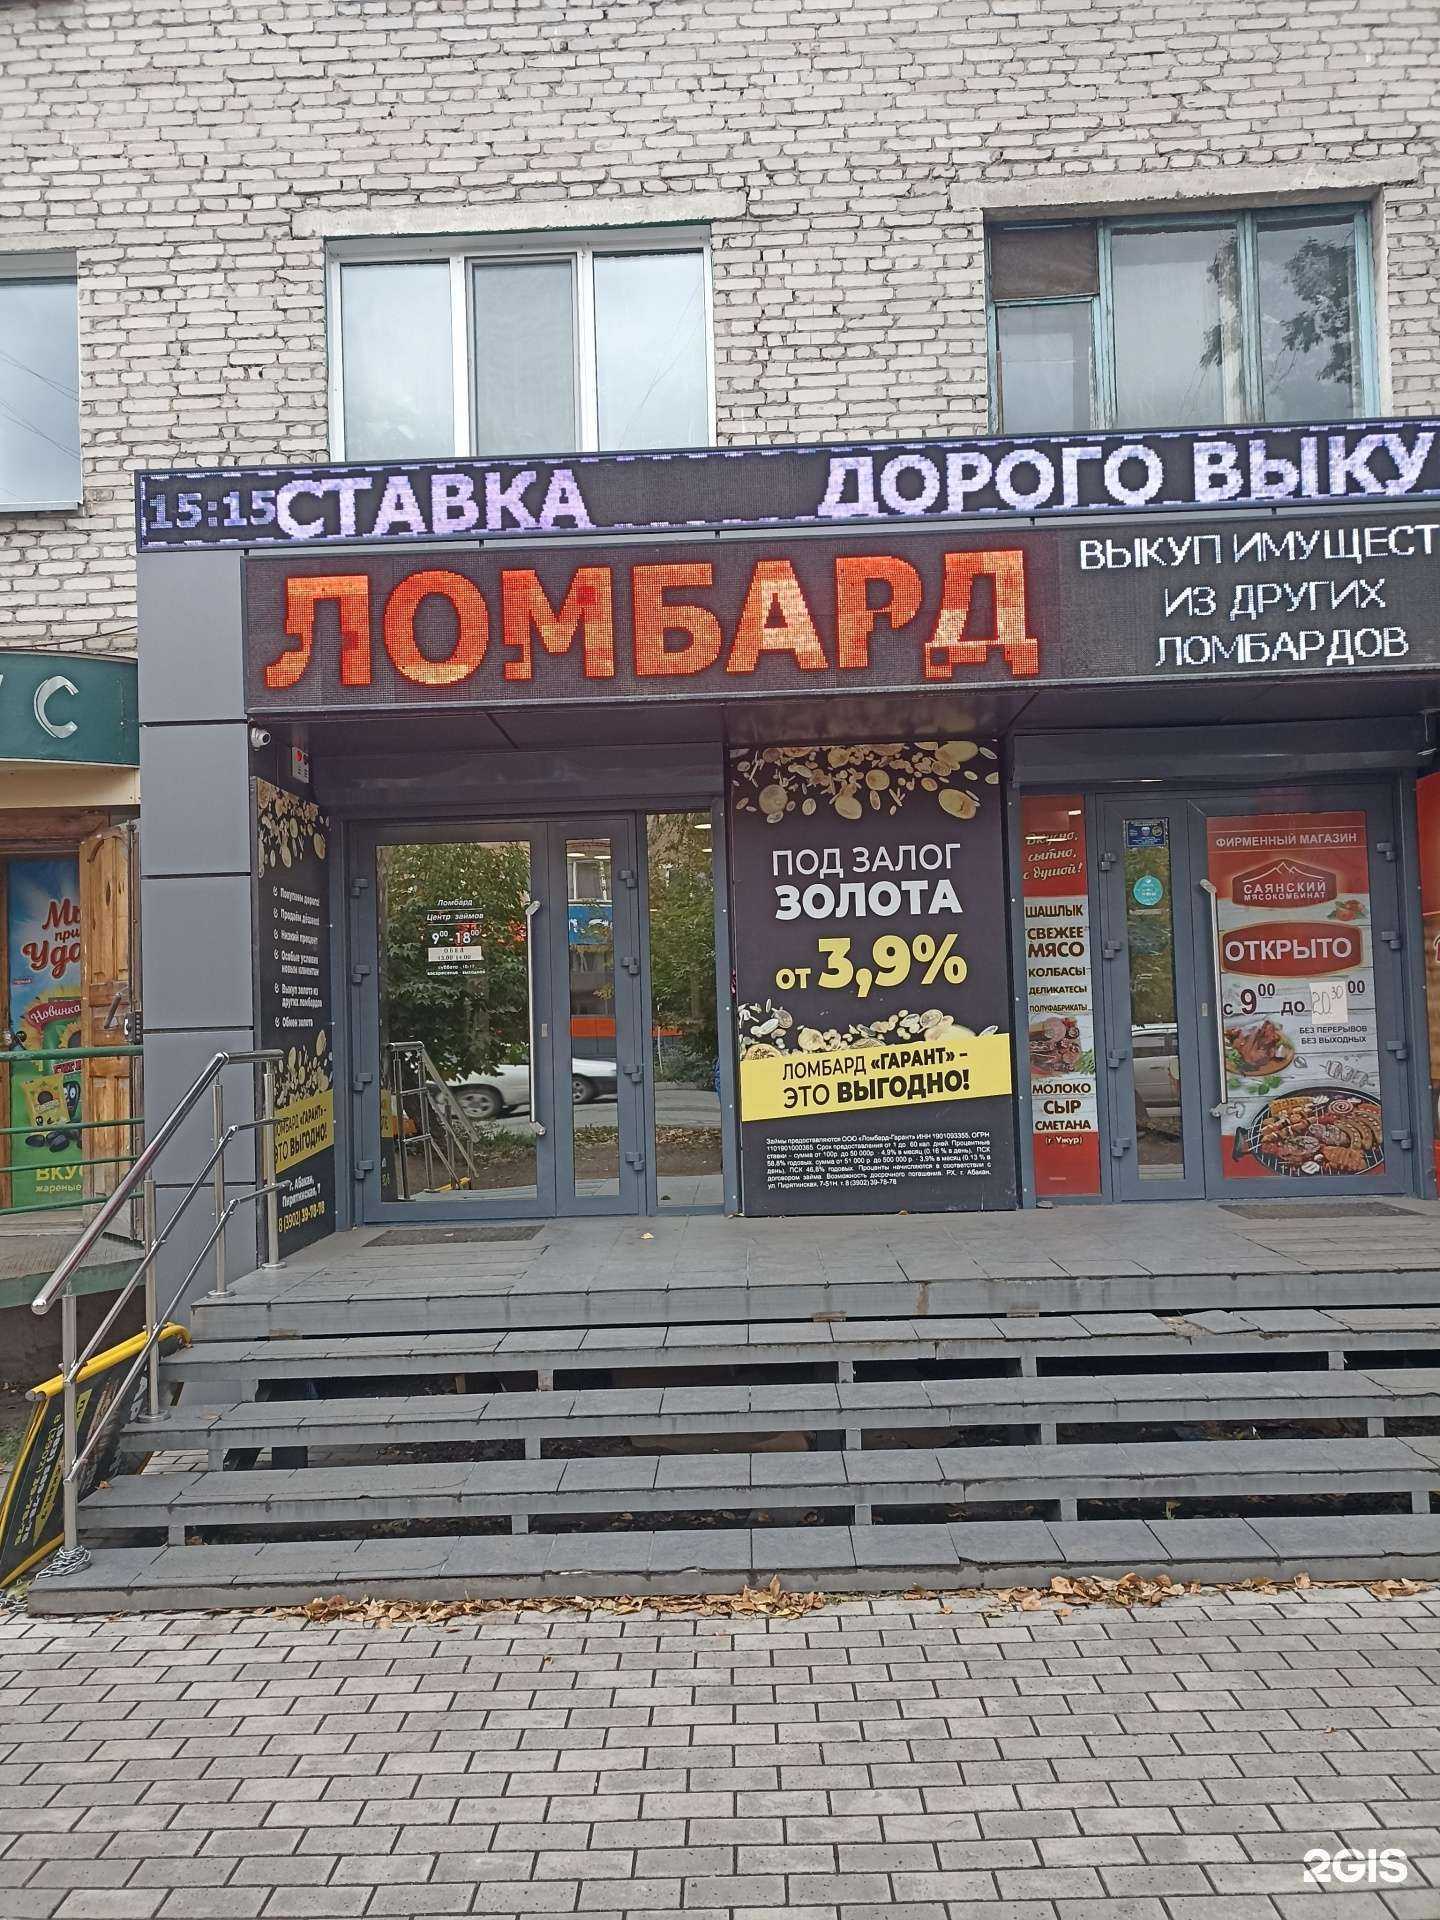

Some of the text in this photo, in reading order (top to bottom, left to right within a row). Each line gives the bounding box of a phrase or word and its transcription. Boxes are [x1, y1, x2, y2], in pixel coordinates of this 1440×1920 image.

[817, 431, 1438, 517] ДОРОГО ВЫКУ
[150, 469, 597, 538] 15:15 СТАВКА
[1080, 524, 1440, 570] ВЫКУП ИМУЩЕСТ
[1165, 578, 1386, 621] ИЗ ДРУГИХ
[264, 549, 1040, 688] ЛОМБАРД
[1155, 626, 1409, 667] ЛОМБАРДОВ
[1216, 833, 1357, 848] ФИРМЕННЫЙ МАГАЗИН
[772, 843, 961, 879] ПОД ЗАЛОГ
[1033, 862, 1083, 882] душой!
[1243, 879, 1326, 895] САЯНСКИЙ
[775, 879, 964, 920] ЗОЛОТА
[1243, 891, 1326, 902] МЯСОКОМБИНАТ
[1025, 904, 1084, 918] ШАШЛЫК
[1027, 926, 1085, 940] СВЕЖЕЕ
[1028, 941, 1085, 958] МЯСО
[1225, 937, 1352, 962] ОТКРЫТО
[775, 933, 968, 998] от 3,9%
[1028, 966, 1087, 978] КОЛБАСЫ
[1029, 985, 1088, 996] ДЕЛИКАТЕСЫ
[30, 1004, 81, 1024] Новинка
[1029, 1003, 1088, 1013] ПОЛУФАБРИКАТЫ
[1281, 1000, 1305, 1016] до
[1316, 1025, 1368, 1034] ПЕРЕРЫВОВ
[1301, 1035, 1367, 1045] БЕЗ ВЫХОДНЫХ
[782, 1047, 956, 1081] ЛОМБАРД «ГАРАНТ»
[783, 1069, 970, 1109] ЭТО ВЫГОДНО!
[1032, 1082, 1092, 1096] МОЛОКО
[1043, 1100, 1082, 1115] СЫР
[275, 1113, 300, 1137] ОМБАРД
[1034, 1119, 1092, 1131] СМЕТАНА
